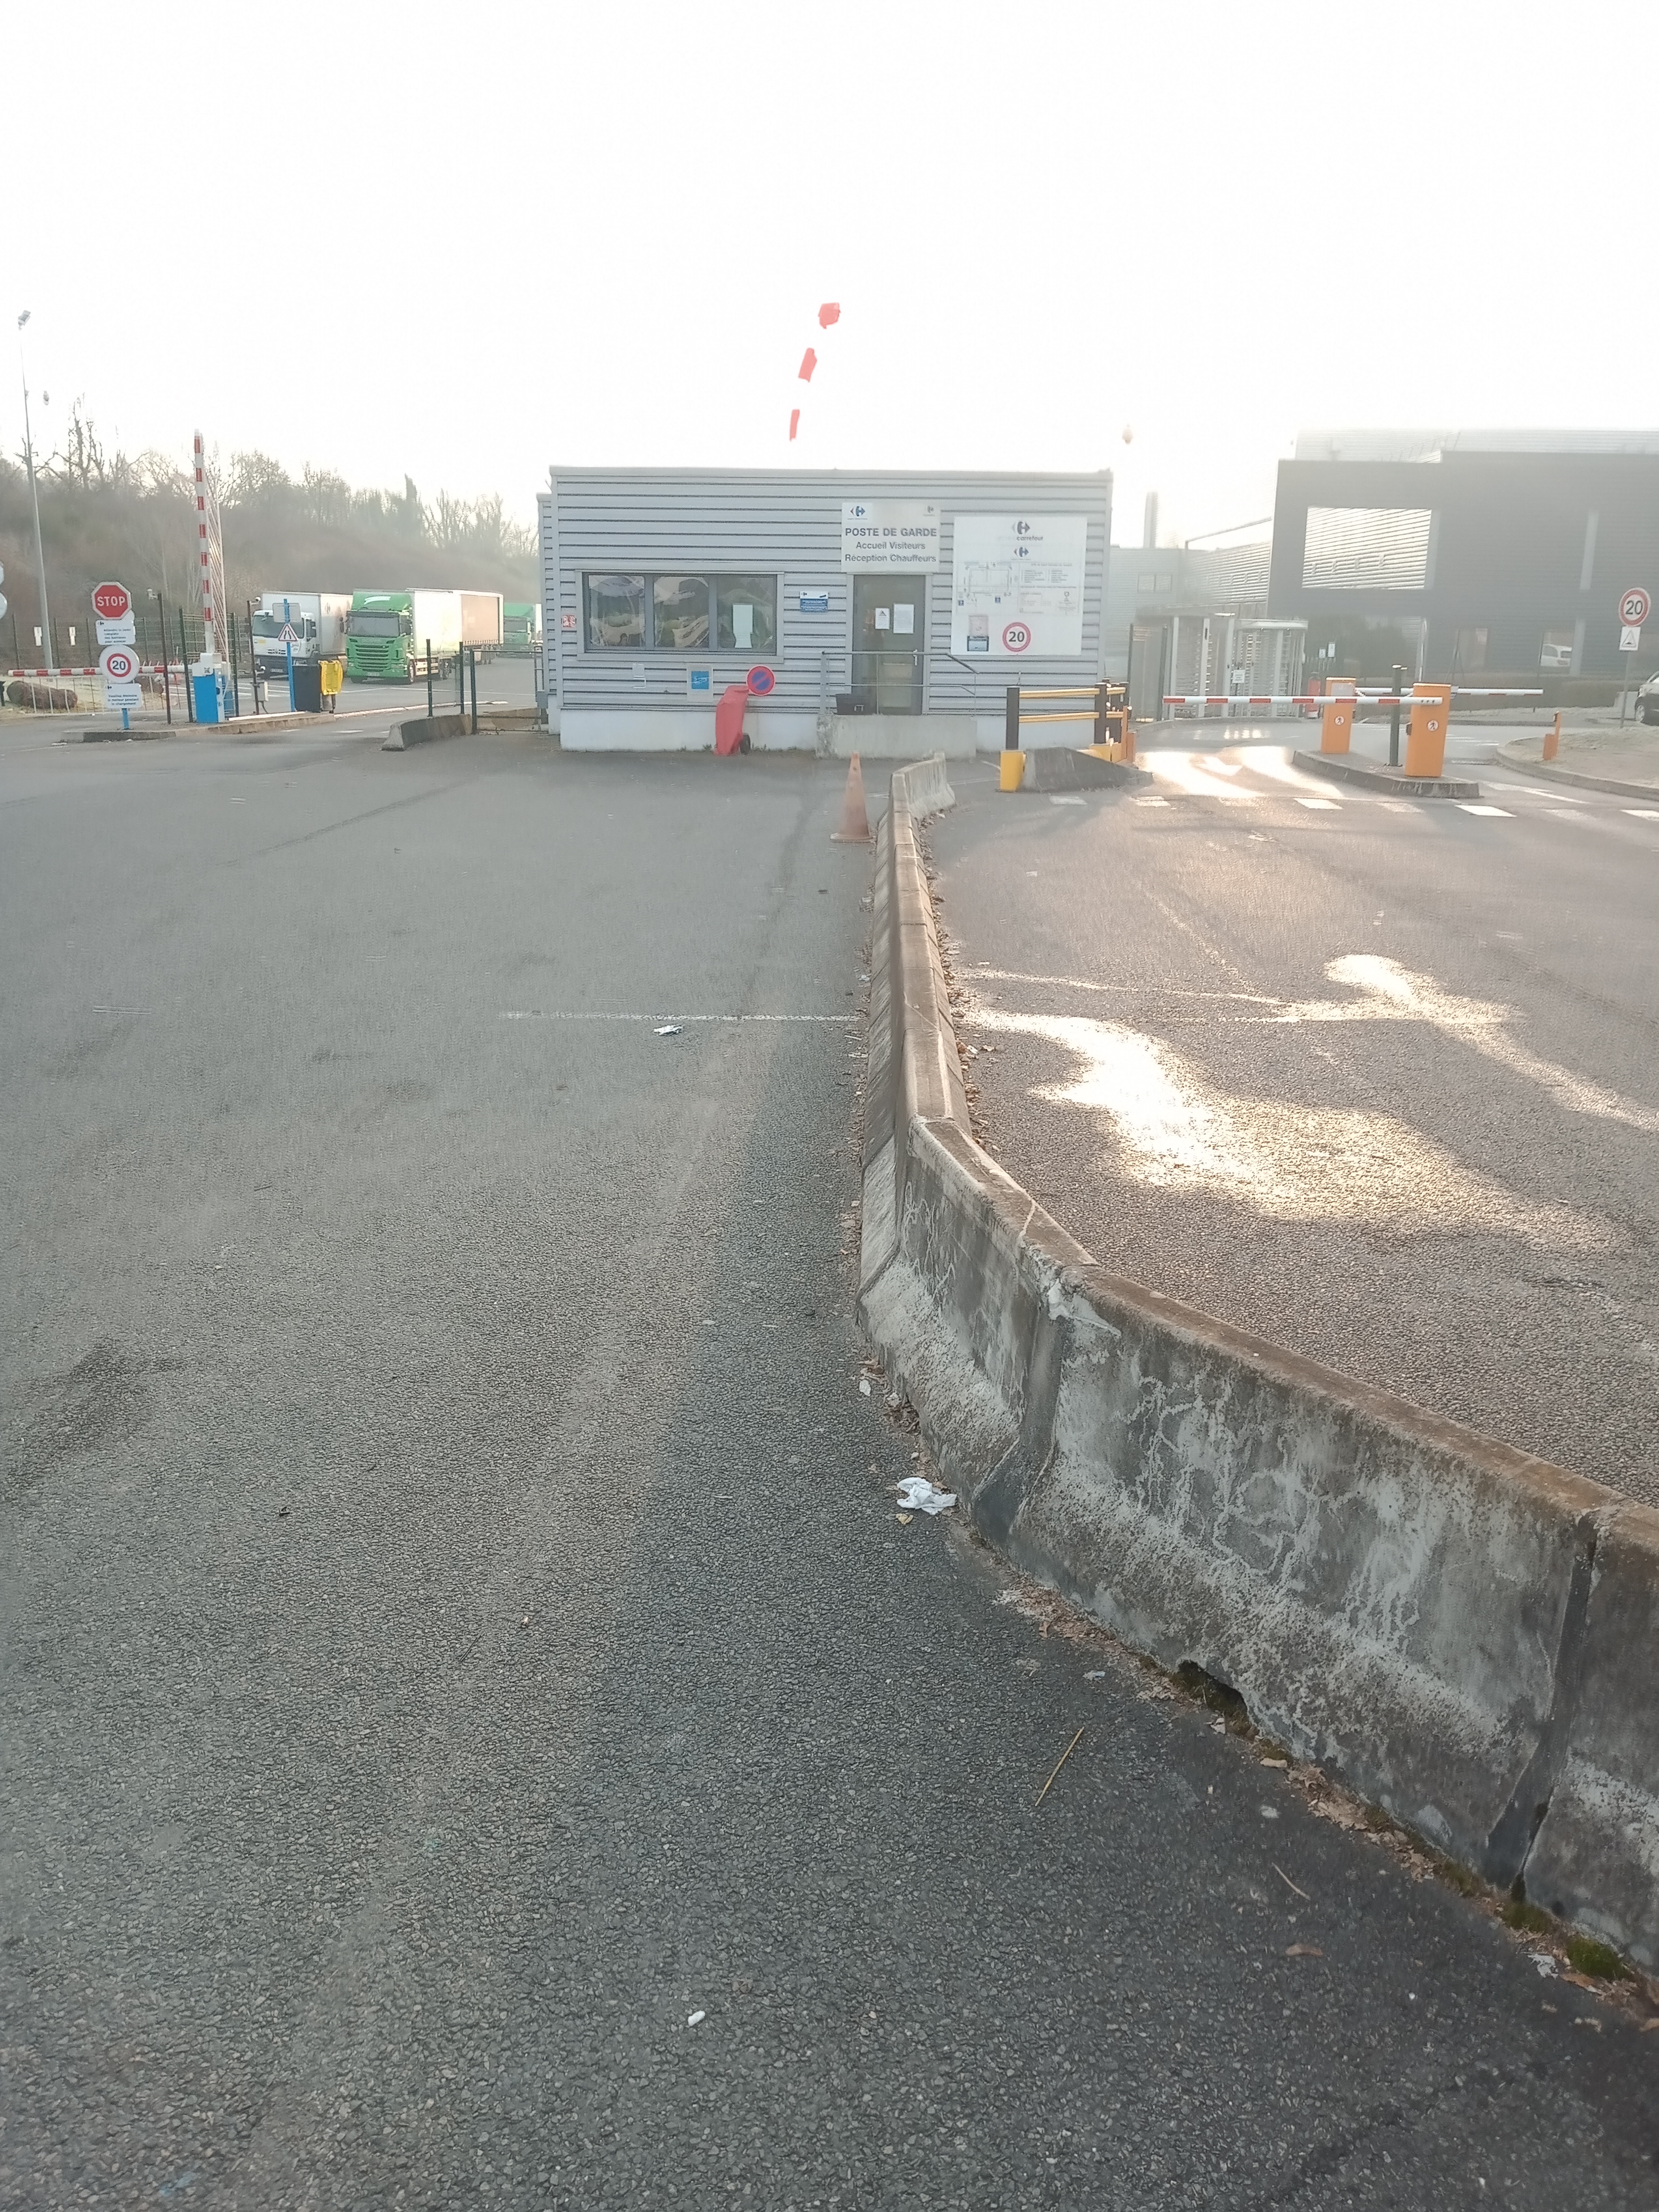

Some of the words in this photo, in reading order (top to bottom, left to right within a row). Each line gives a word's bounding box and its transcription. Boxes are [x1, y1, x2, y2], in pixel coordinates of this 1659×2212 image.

[845, 528, 879, 537] POSTE
[883, 528, 897, 537] DE
[900, 528, 937, 537] GARDE
[845, 554, 887, 563] Réception
[890, 554, 937, 563] Chauffeurs
[97, 596, 125, 606] STOP
[1626, 600, 1643, 615] 20
[1008, 631, 1025, 642] 20
[112, 660, 126, 670] 20
